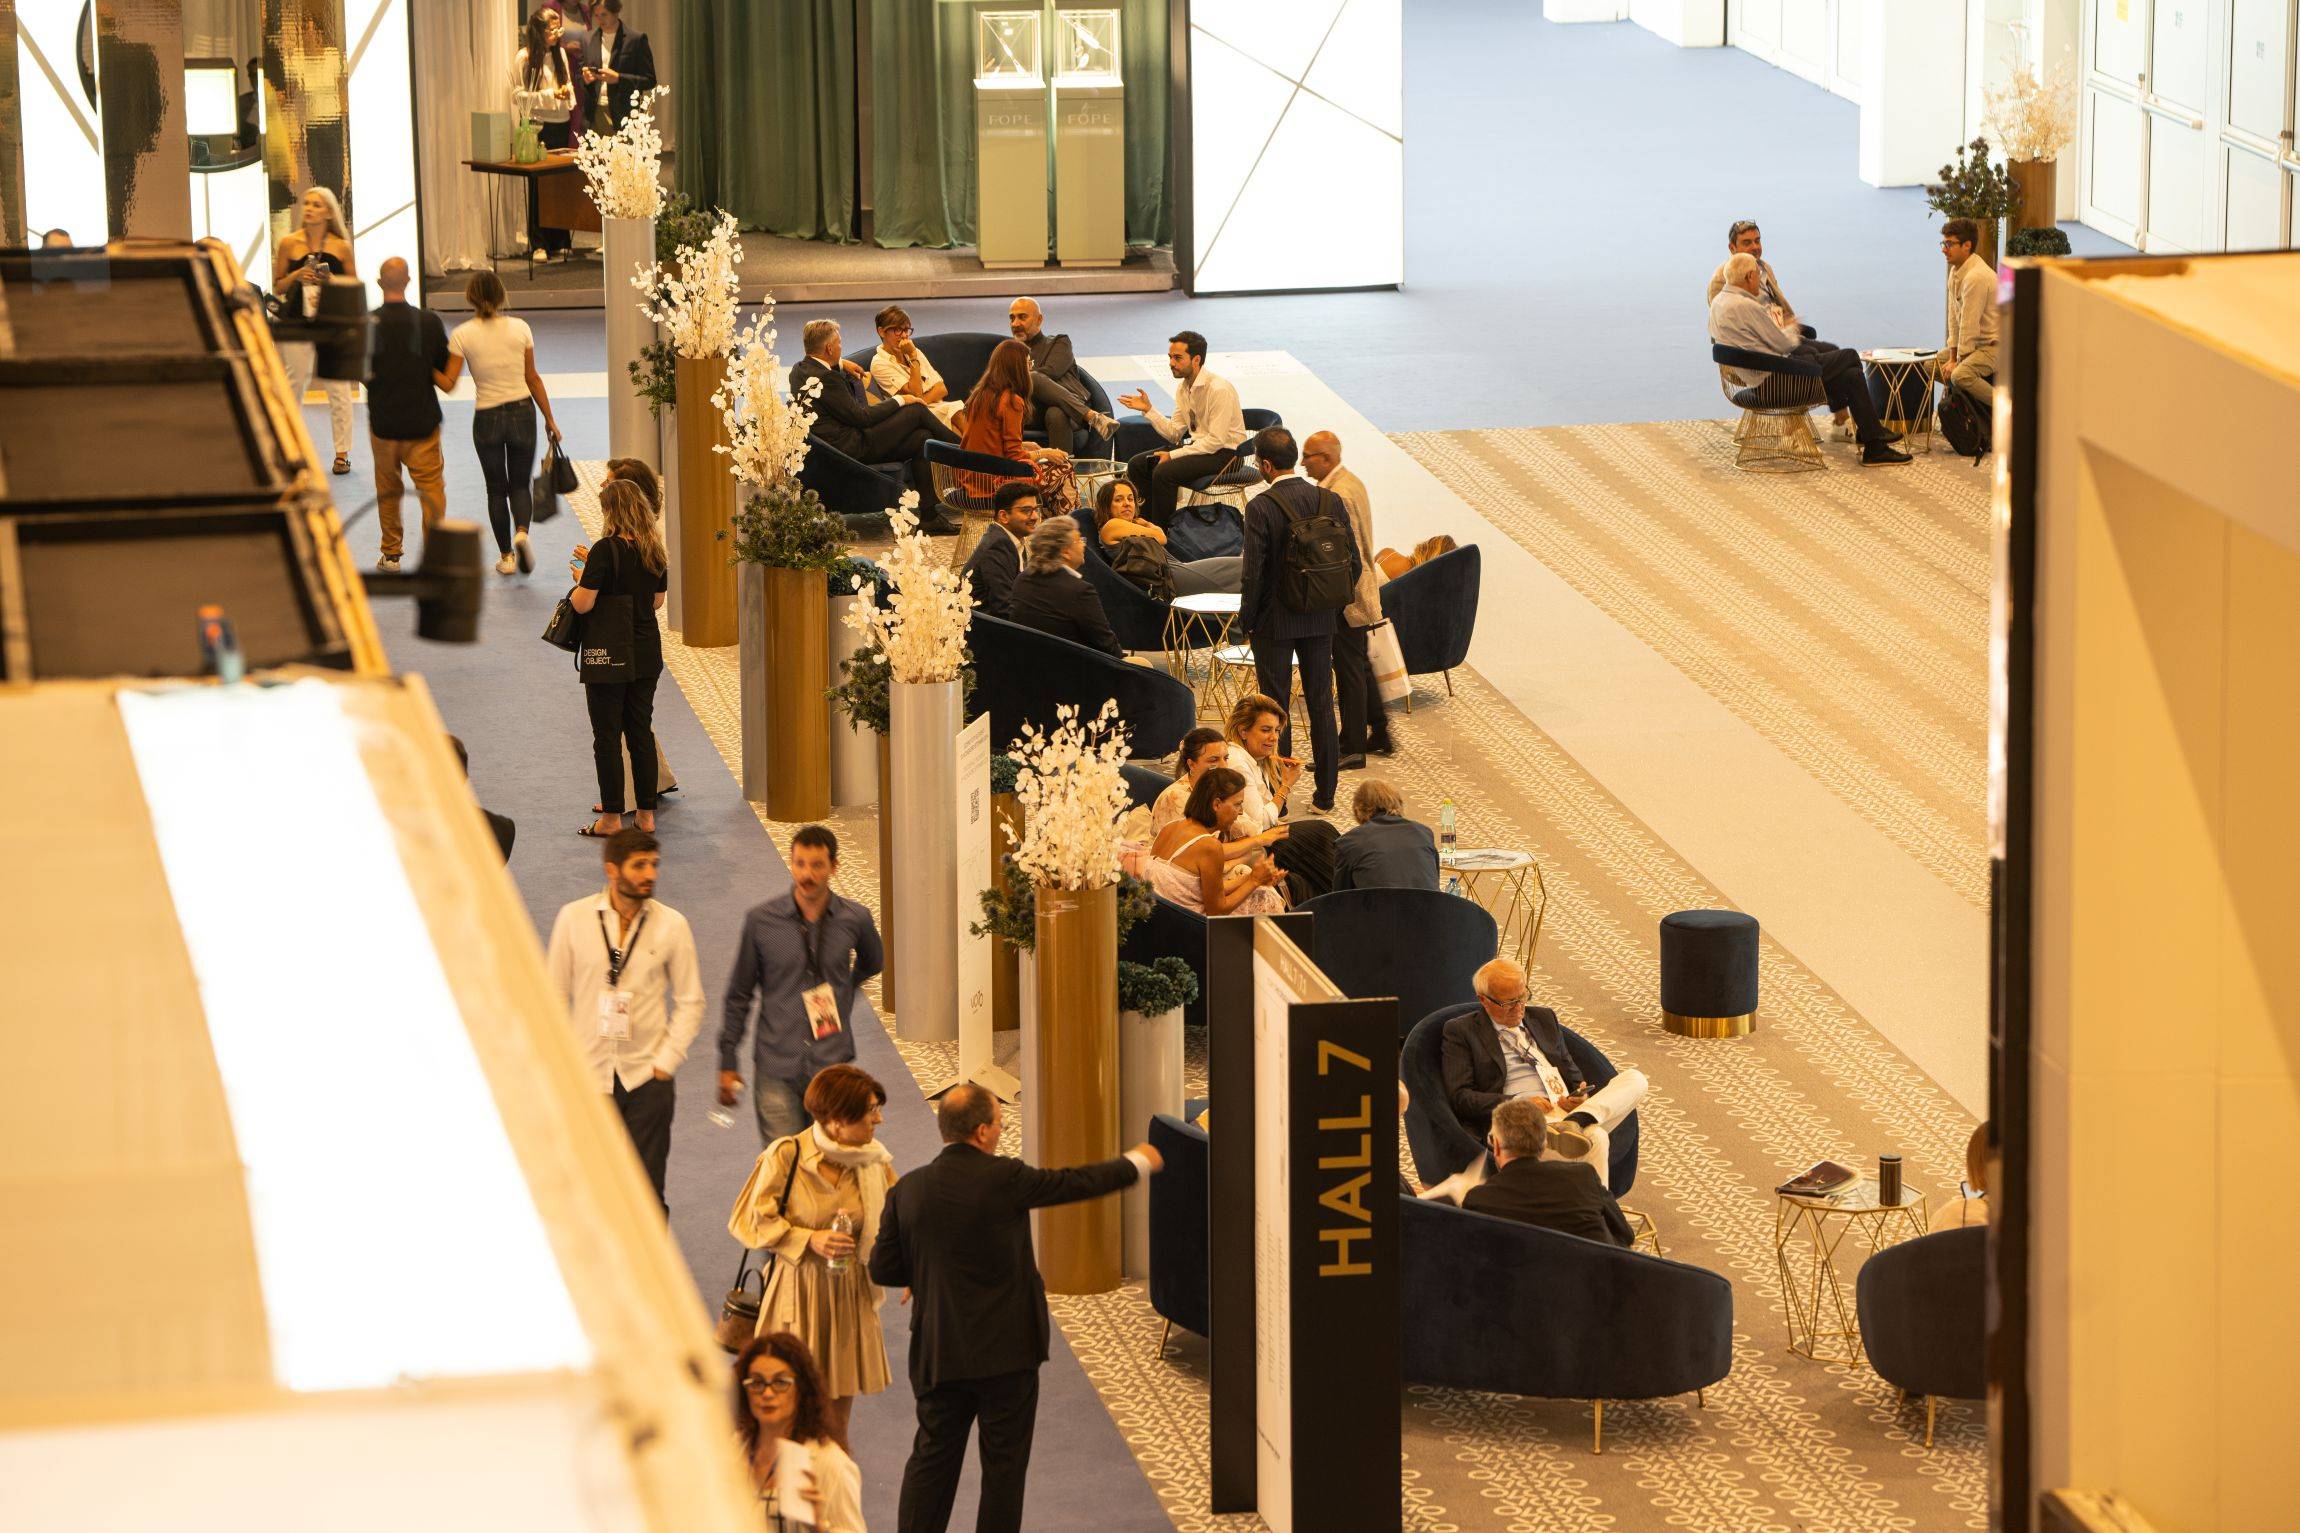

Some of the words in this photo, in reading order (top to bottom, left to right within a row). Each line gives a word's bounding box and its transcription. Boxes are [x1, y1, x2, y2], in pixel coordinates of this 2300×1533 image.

[989, 114, 1033, 125] FOPE
[1068, 113, 1112, 124] FOPE
[584, 648, 607, 657] DESIGN
[1318, 1039, 1372, 1076] 7
[1318, 1094, 1373, 1277] HALL
